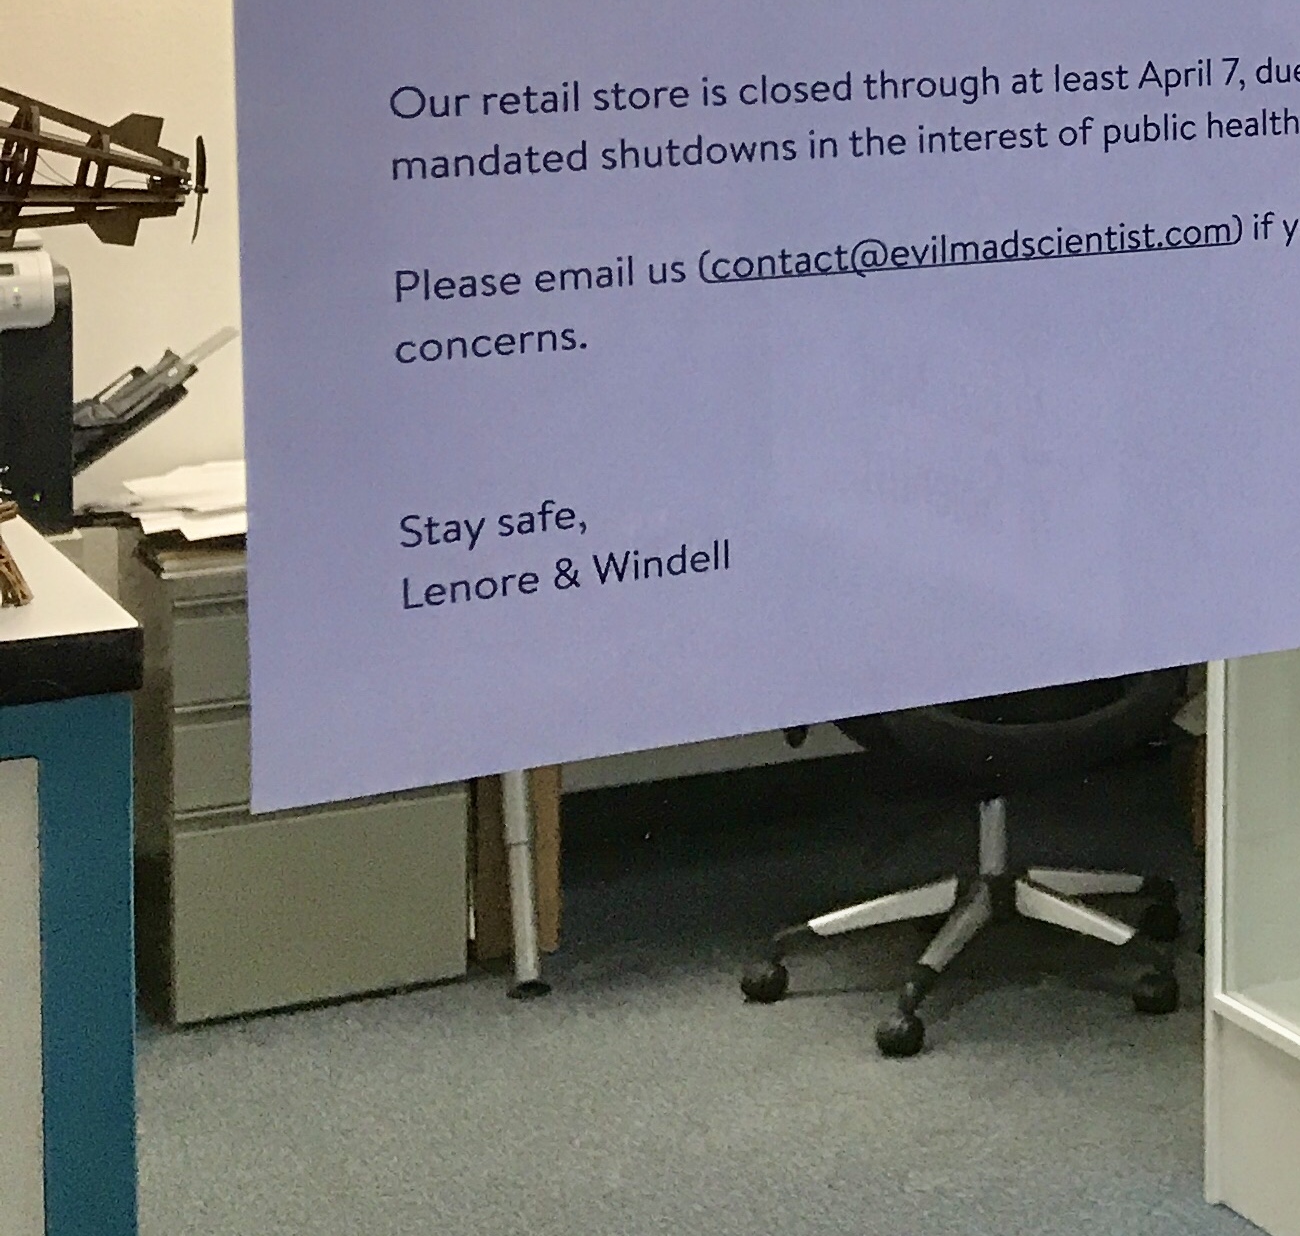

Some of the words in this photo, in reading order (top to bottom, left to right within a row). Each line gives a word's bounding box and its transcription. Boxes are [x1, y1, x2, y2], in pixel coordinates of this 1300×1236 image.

[390, 86, 470, 119] Our
[483, 81, 579, 115] retail
[593, 83, 689, 111] store
[702, 77, 726, 106] is
[740, 71, 851, 105] closed
[863, 66, 999, 104] through
[1012, 68, 1043, 94] at
[1054, 64, 1129, 92] least
[1138, 58, 1211, 97] April
[1222, 58, 1245, 91] 7,
[393, 140, 587, 180] mandated
[602, 134, 797, 170] shutdowns
[809, 130, 837, 159] in
[849, 127, 906, 157] the
[919, 122, 1048, 154] interest
[1059, 116, 1094, 146] of
[1104, 113, 1197, 153] public
[395, 269, 521, 302] Please
[535, 255, 633, 292] email
[649, 262, 686, 284] us
[699, 214, 1242, 283] (contact@evilmadscientist.com)
[1253, 211, 1275, 240] if
[395, 329, 587, 363] concerns.
[400, 515, 485, 551] Stay
[498, 500, 586, 537] safe,
[403, 572, 539, 609] Lenore
[554, 558, 580, 590] &
[592, 539, 729, 585] Windell
